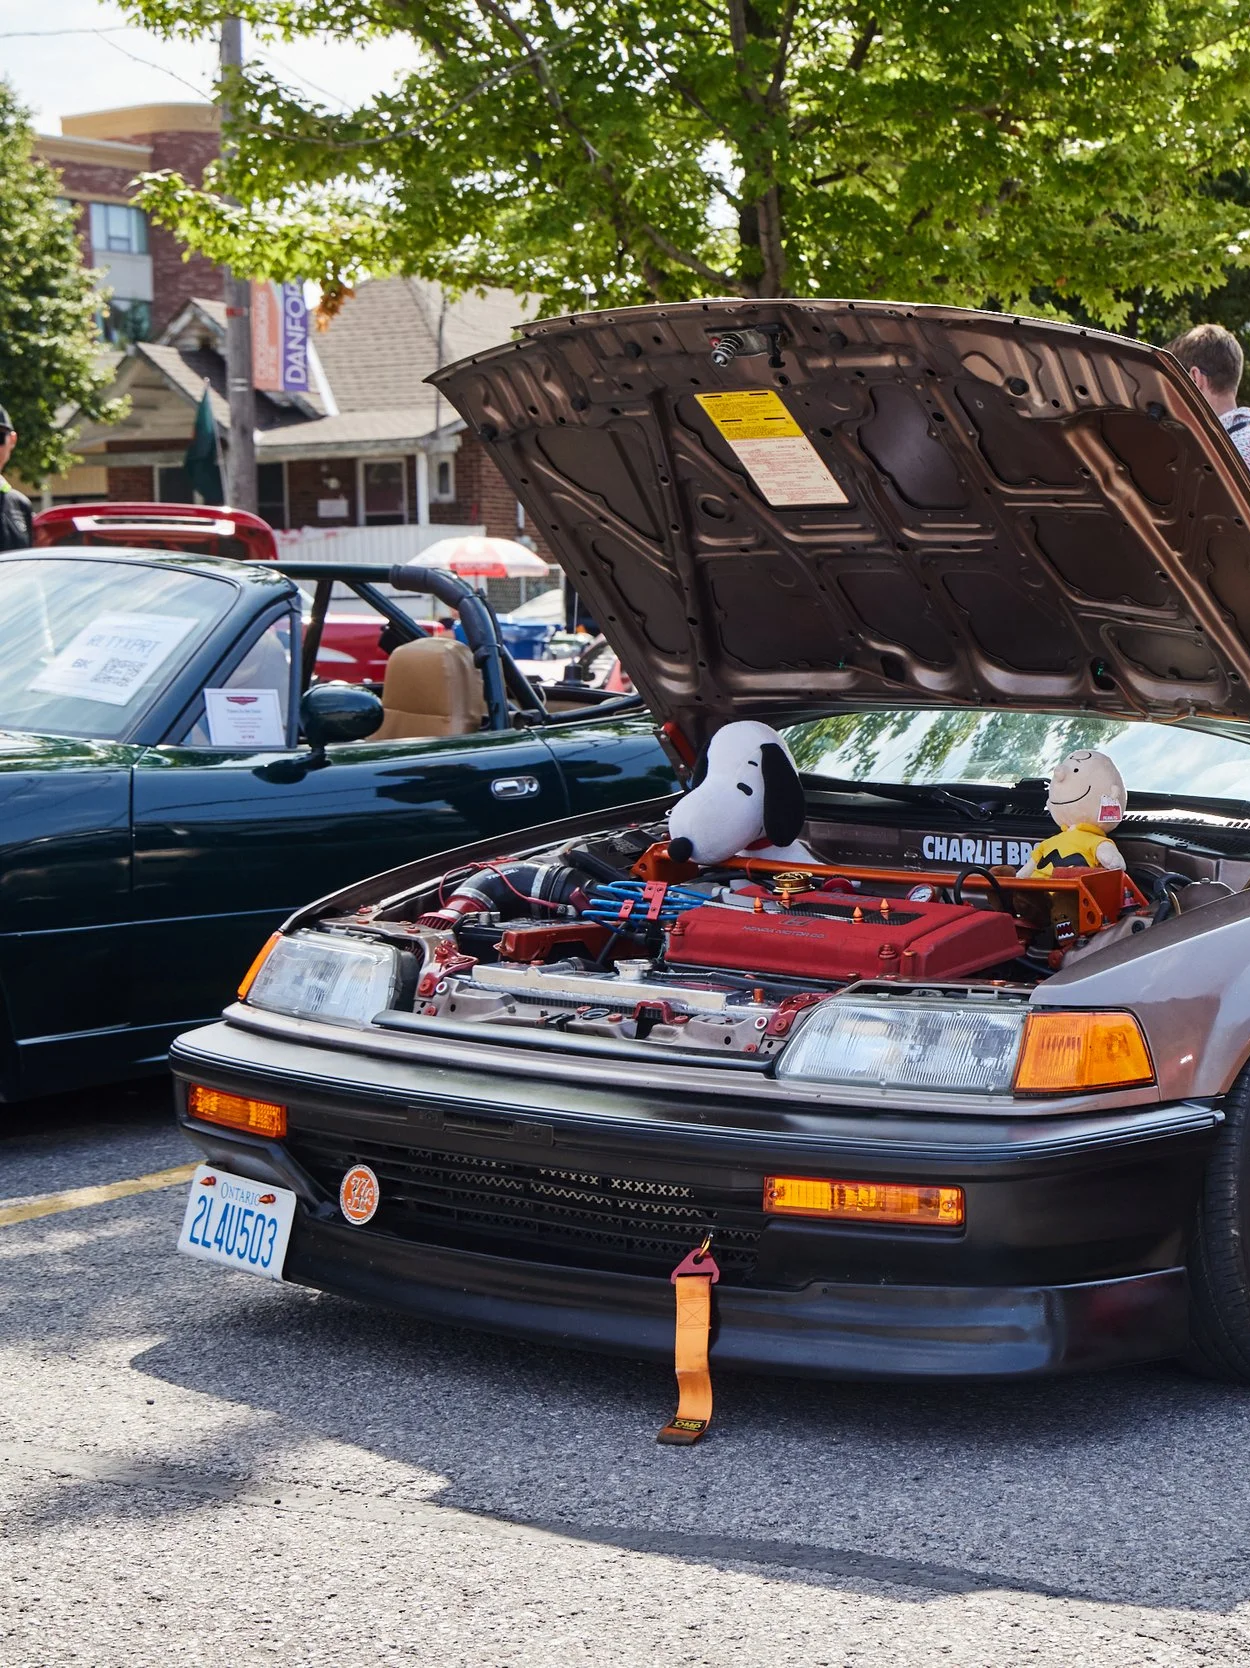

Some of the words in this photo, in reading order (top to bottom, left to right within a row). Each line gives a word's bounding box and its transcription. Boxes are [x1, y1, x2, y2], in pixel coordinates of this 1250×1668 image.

[922, 835, 1002, 866] CHARLIE
[1007, 841, 1042, 866] BR
[189, 1195, 278, 1268] 2L4U503
